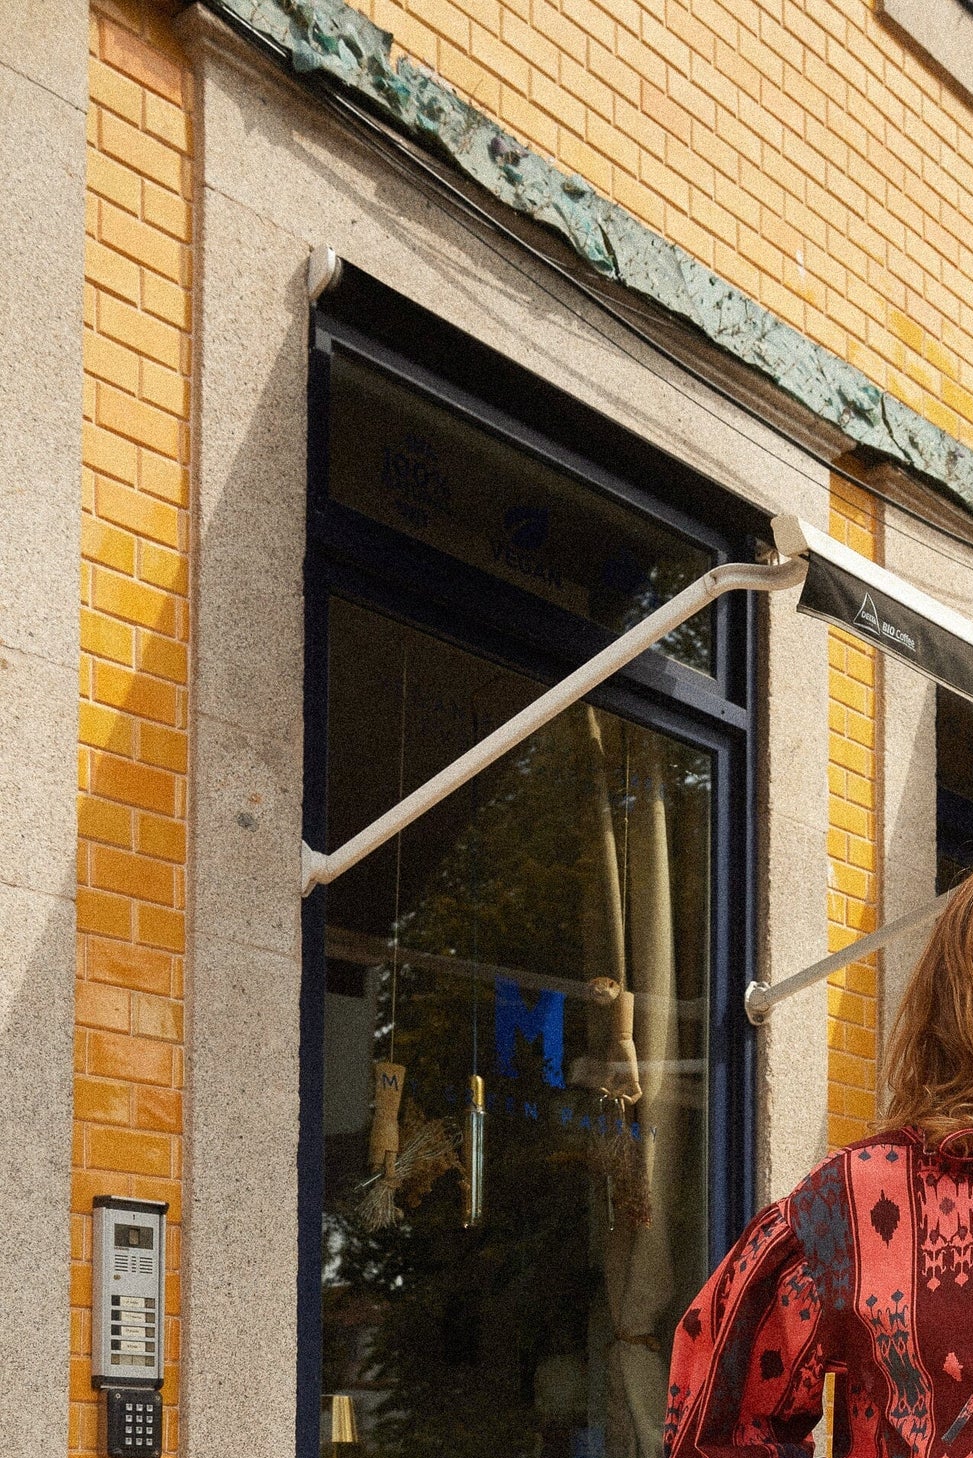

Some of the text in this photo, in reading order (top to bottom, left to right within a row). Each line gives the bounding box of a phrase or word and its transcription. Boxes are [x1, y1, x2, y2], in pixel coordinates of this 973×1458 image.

[489, 537, 563, 590] VEGAN
[882, 621, 915, 649] BIO Coffee
[495, 975, 566, 1089] M
